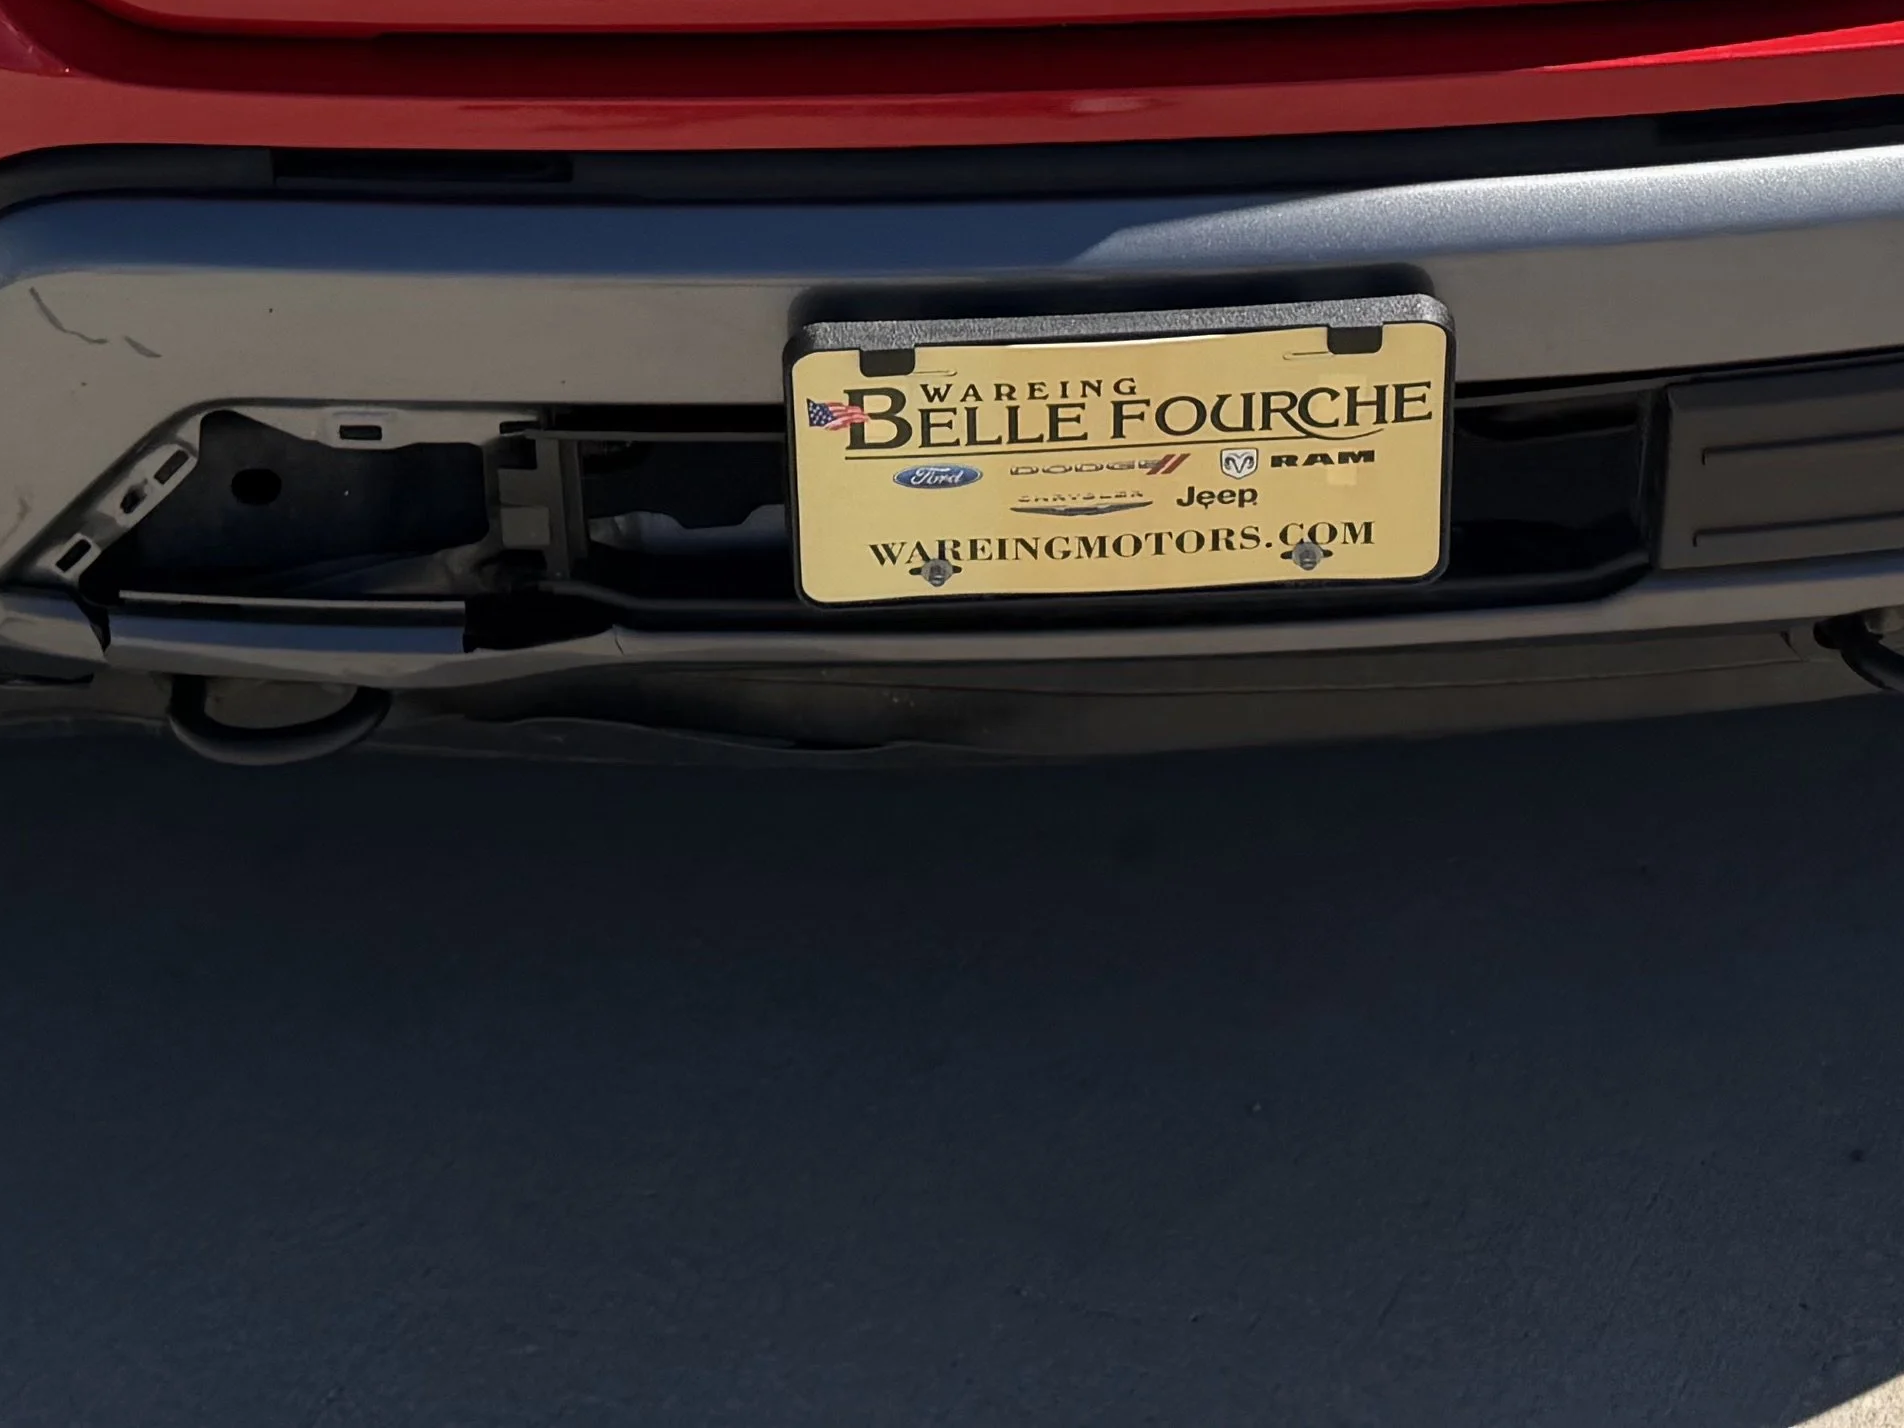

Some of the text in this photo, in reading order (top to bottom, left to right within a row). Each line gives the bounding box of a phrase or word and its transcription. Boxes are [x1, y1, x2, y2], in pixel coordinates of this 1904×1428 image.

[919, 377, 1137, 403] WAREING
[1110, 380, 1433, 441] FOURCHE
[1010, 460, 1160, 476] DODGE
[1270, 449, 1375, 468] RAM
[910, 467, 964, 485] Ford
[1176, 485, 1259, 510] Jeep
[868, 520, 1375, 566] WAREINGMOTORS.COM
